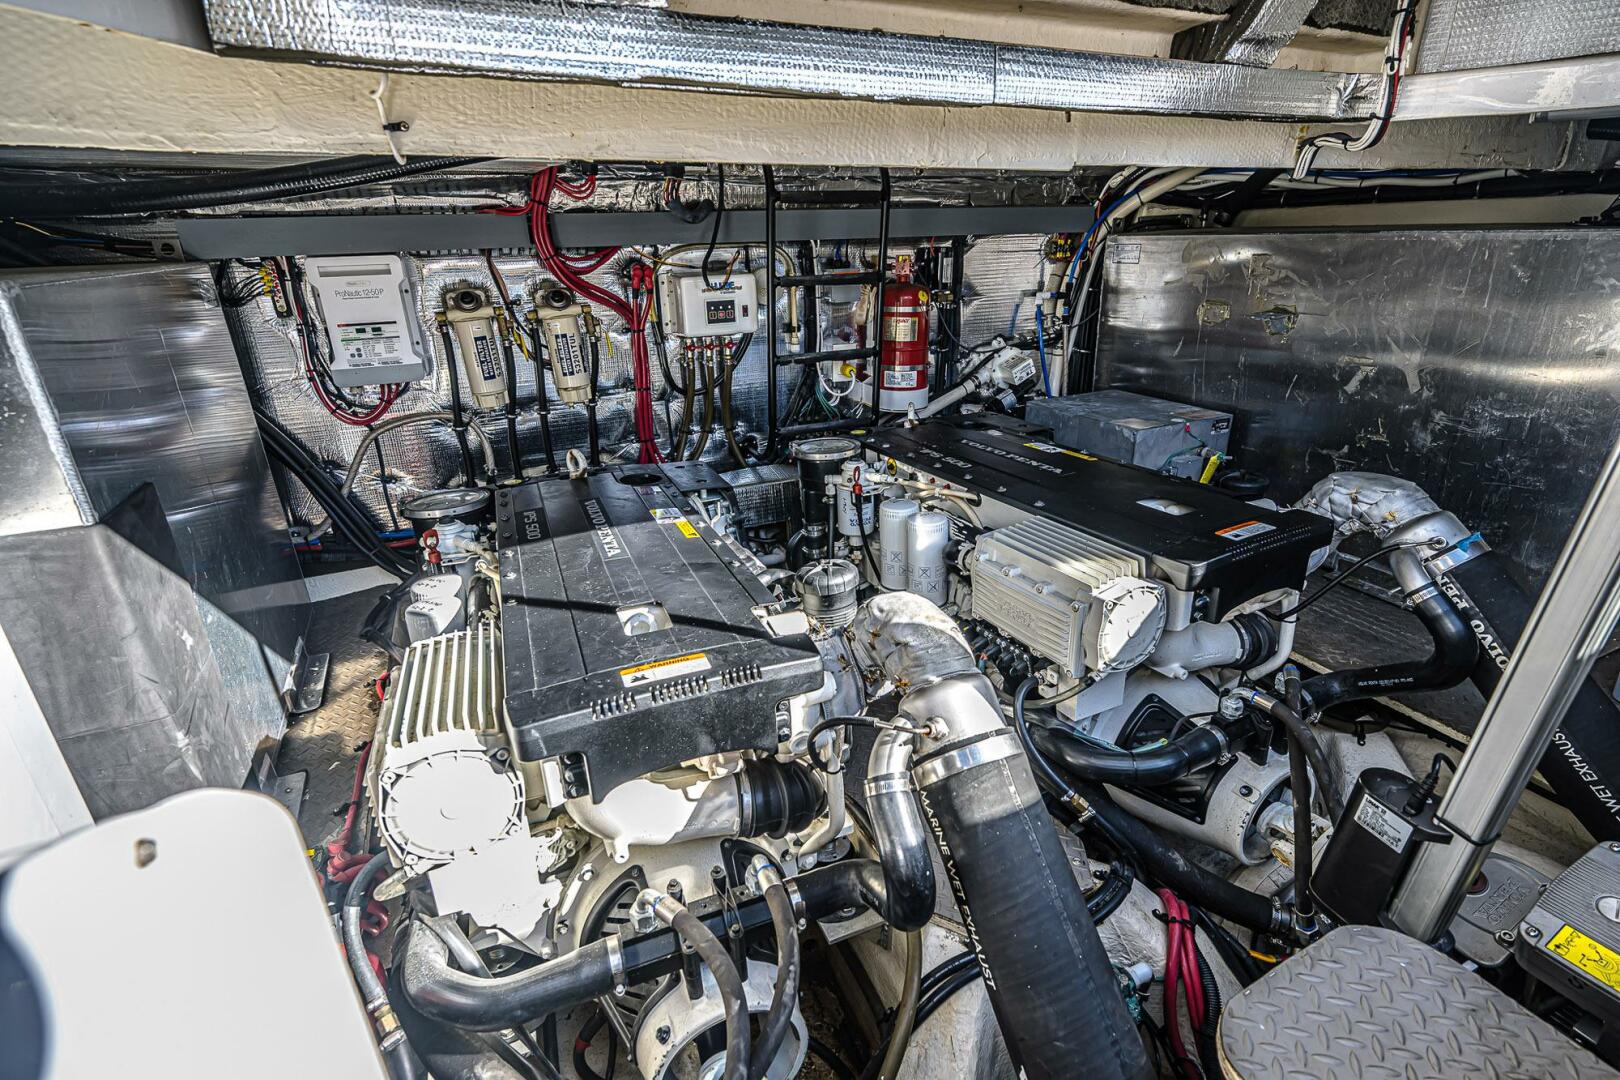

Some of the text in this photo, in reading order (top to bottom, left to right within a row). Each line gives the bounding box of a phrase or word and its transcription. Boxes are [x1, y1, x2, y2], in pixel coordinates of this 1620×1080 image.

[334, 288, 362, 297] ProNautic
[476, 340, 486, 360] FILTER
[570, 333, 582, 373] S3201TUL
[961, 439, 1006, 455] VOLVO
[1006, 454, 1064, 474] PENTA
[525, 522, 541, 538] 900
[584, 499, 621, 557] VOLVO PENTA
[1434, 572, 1509, 671] OLVO PEN
[1552, 726, 1620, 812] WET EXHAUS
[920, 791, 996, 991] MARINE WET EXHAUST
